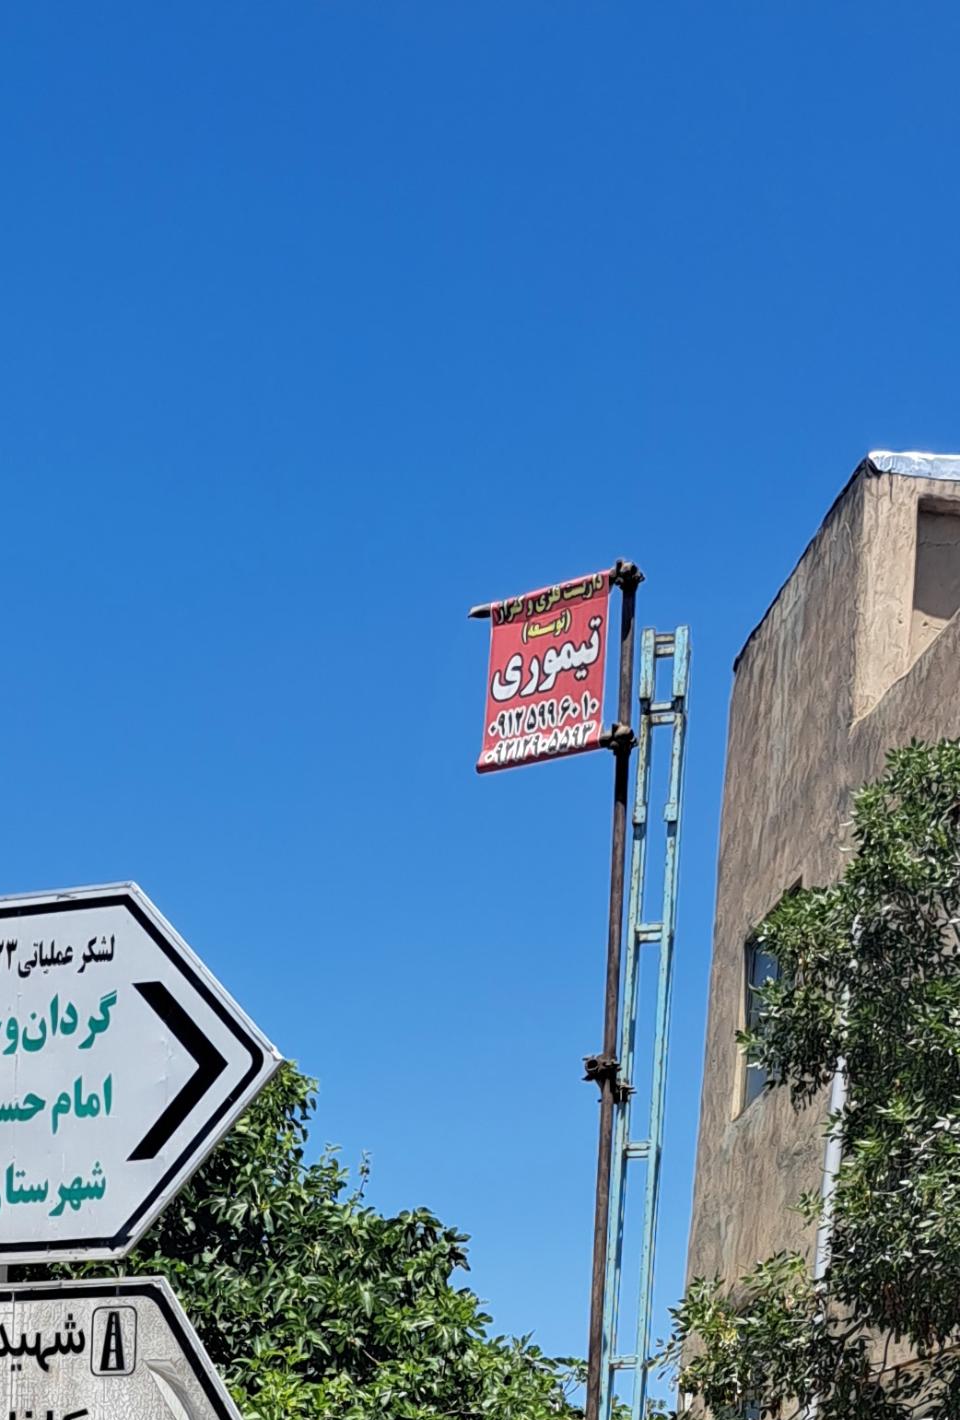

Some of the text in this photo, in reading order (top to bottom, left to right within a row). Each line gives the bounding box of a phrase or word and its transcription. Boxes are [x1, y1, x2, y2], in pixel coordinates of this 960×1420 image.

[491, 617, 603, 702] تیموری
[17, 945, 74, 980] عملیاتی
[77, 933, 116, 974] لشکر
[3, 1019, 20, 1055] و
[21, 989, 118, 1051] گردان
[50, 1073, 113, 1132] امام
